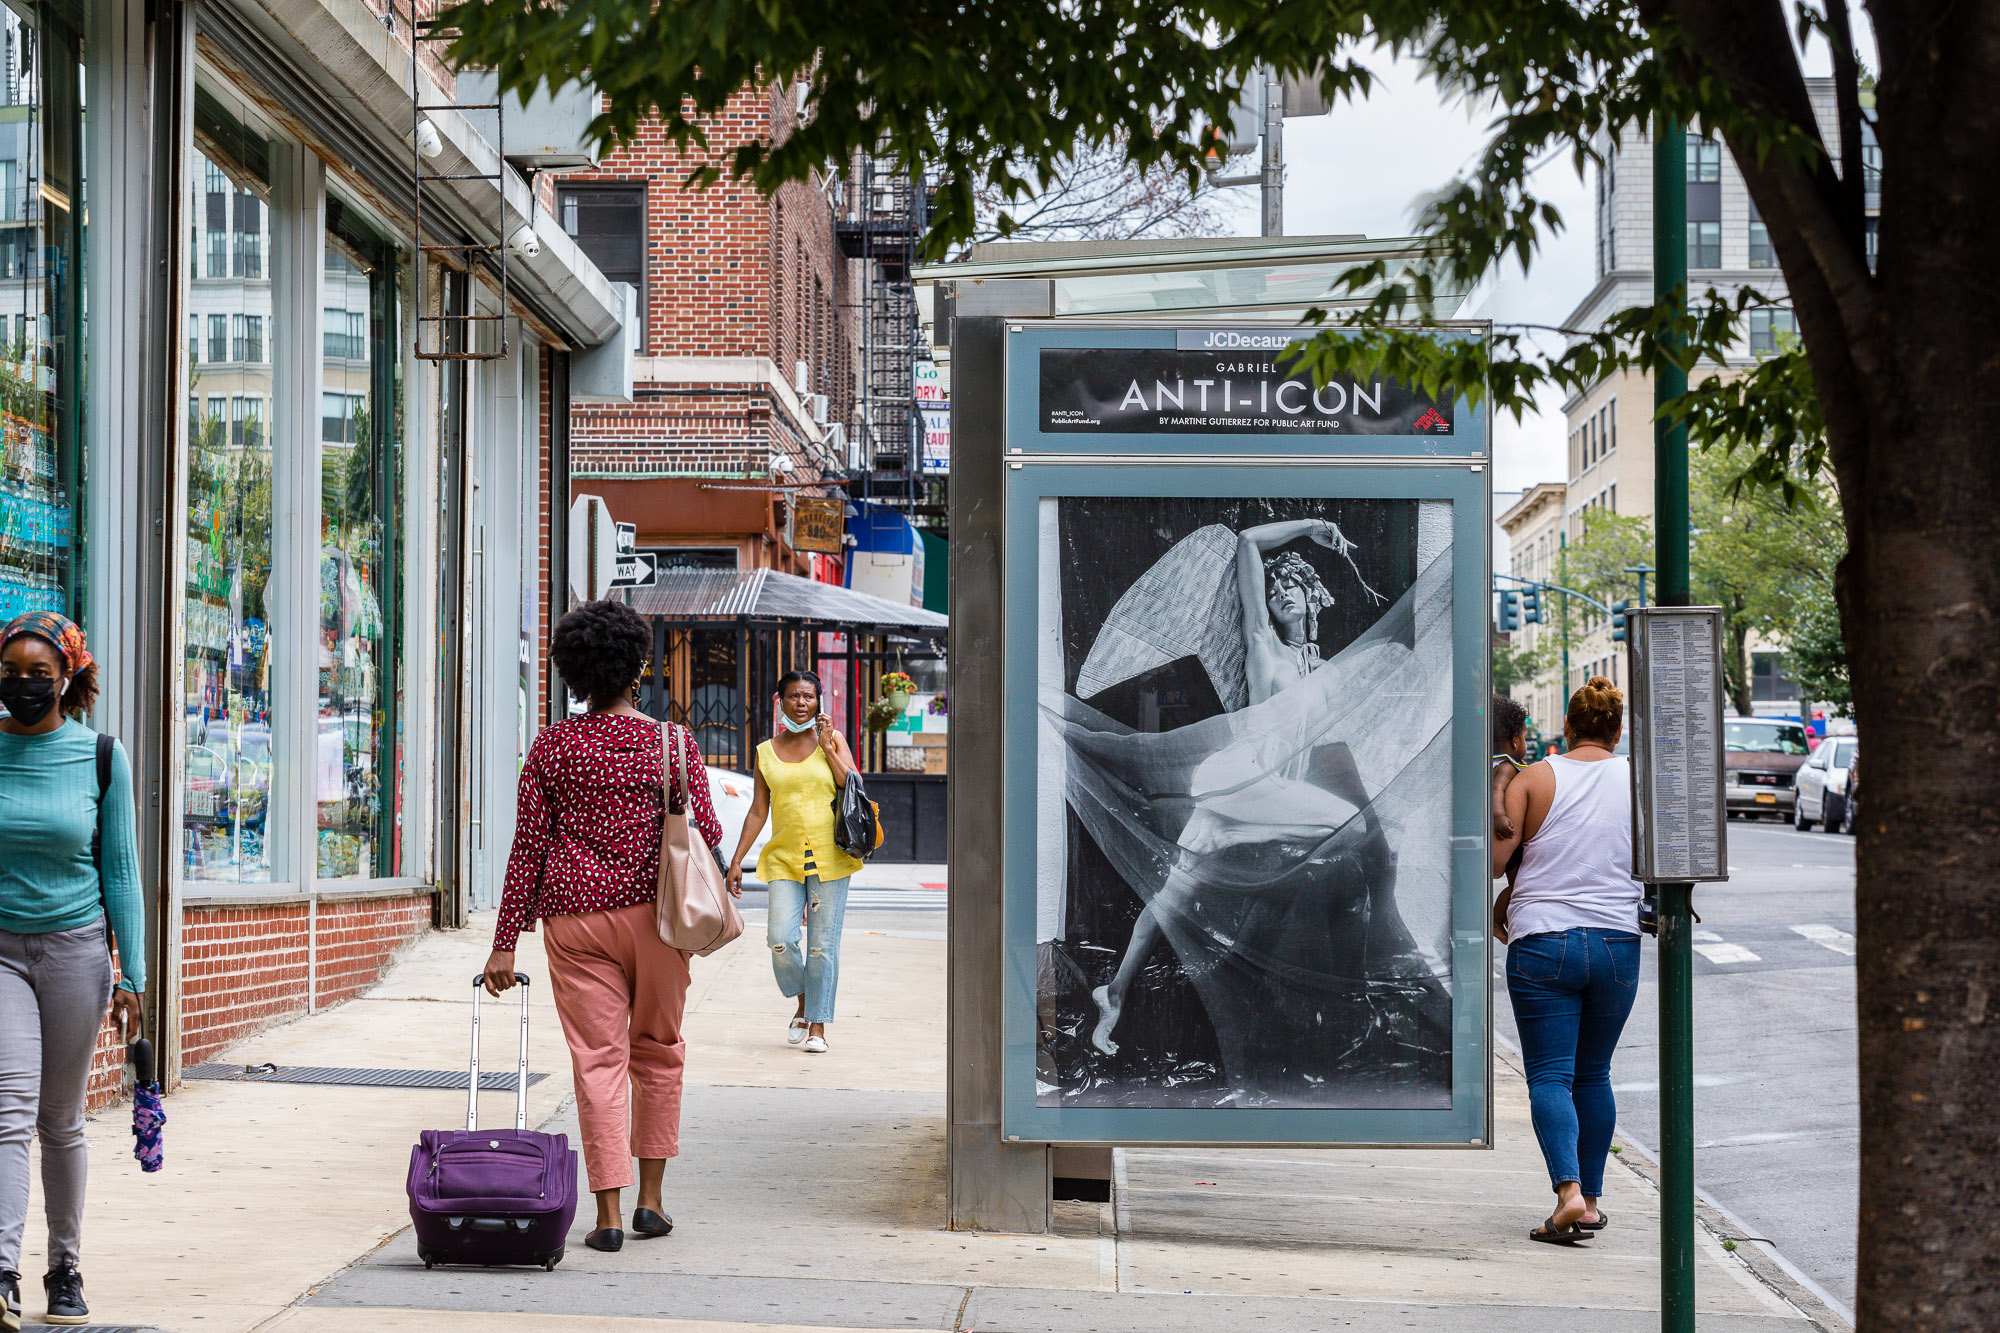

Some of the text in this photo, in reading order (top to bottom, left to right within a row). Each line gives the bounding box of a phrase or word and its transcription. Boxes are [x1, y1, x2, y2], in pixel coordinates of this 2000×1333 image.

[1203, 331, 1292, 348] JCDecaux
[1216, 362, 1277, 373] GABRIEL
[1118, 378, 1381, 416] ANTI-ICON
[1051, 418, 1101, 426] PublicArtFund.org
[1159, 416, 1340, 428] BY MARTINE GUTIERREZ FOR PUBLIC ART FUND
[1413, 407, 1436, 430] PUBLIC
[616, 564, 637, 577] WAY
